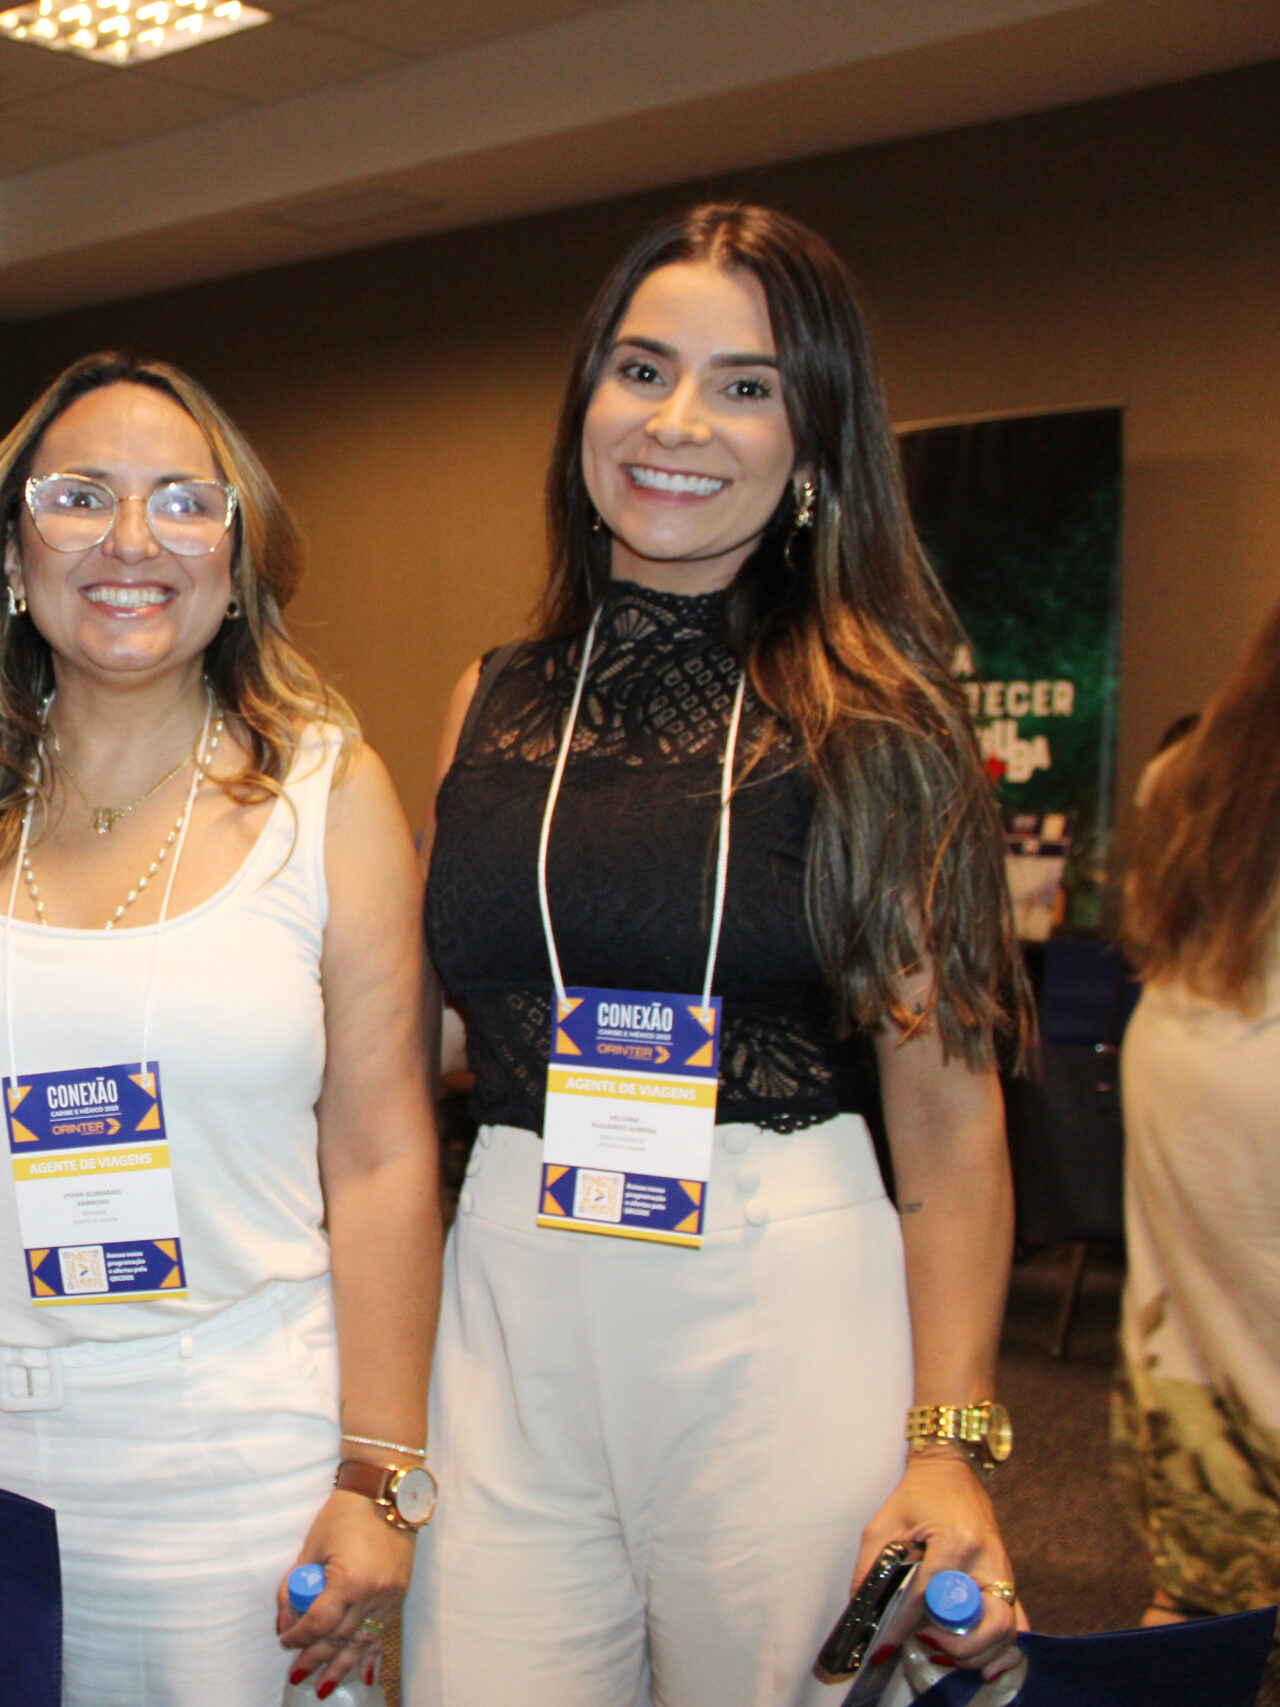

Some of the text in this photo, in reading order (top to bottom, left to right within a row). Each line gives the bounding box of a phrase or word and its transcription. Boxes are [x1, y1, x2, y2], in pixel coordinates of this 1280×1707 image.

[596, 1001, 674, 1032] CONEXÃO
[597, 1042, 652, 1057] ORINTER
[47, 1076, 118, 1109] CONEXÃO
[565, 1076, 696, 1100] AGENTE DE VIAGENS
[50, 1109, 73, 1117] CARIBE
[79, 1105, 103, 1114] MÉXICO
[51, 1120, 104, 1135] ORINTER
[29, 1152, 152, 1174] AGENTE DE VIAGENS
